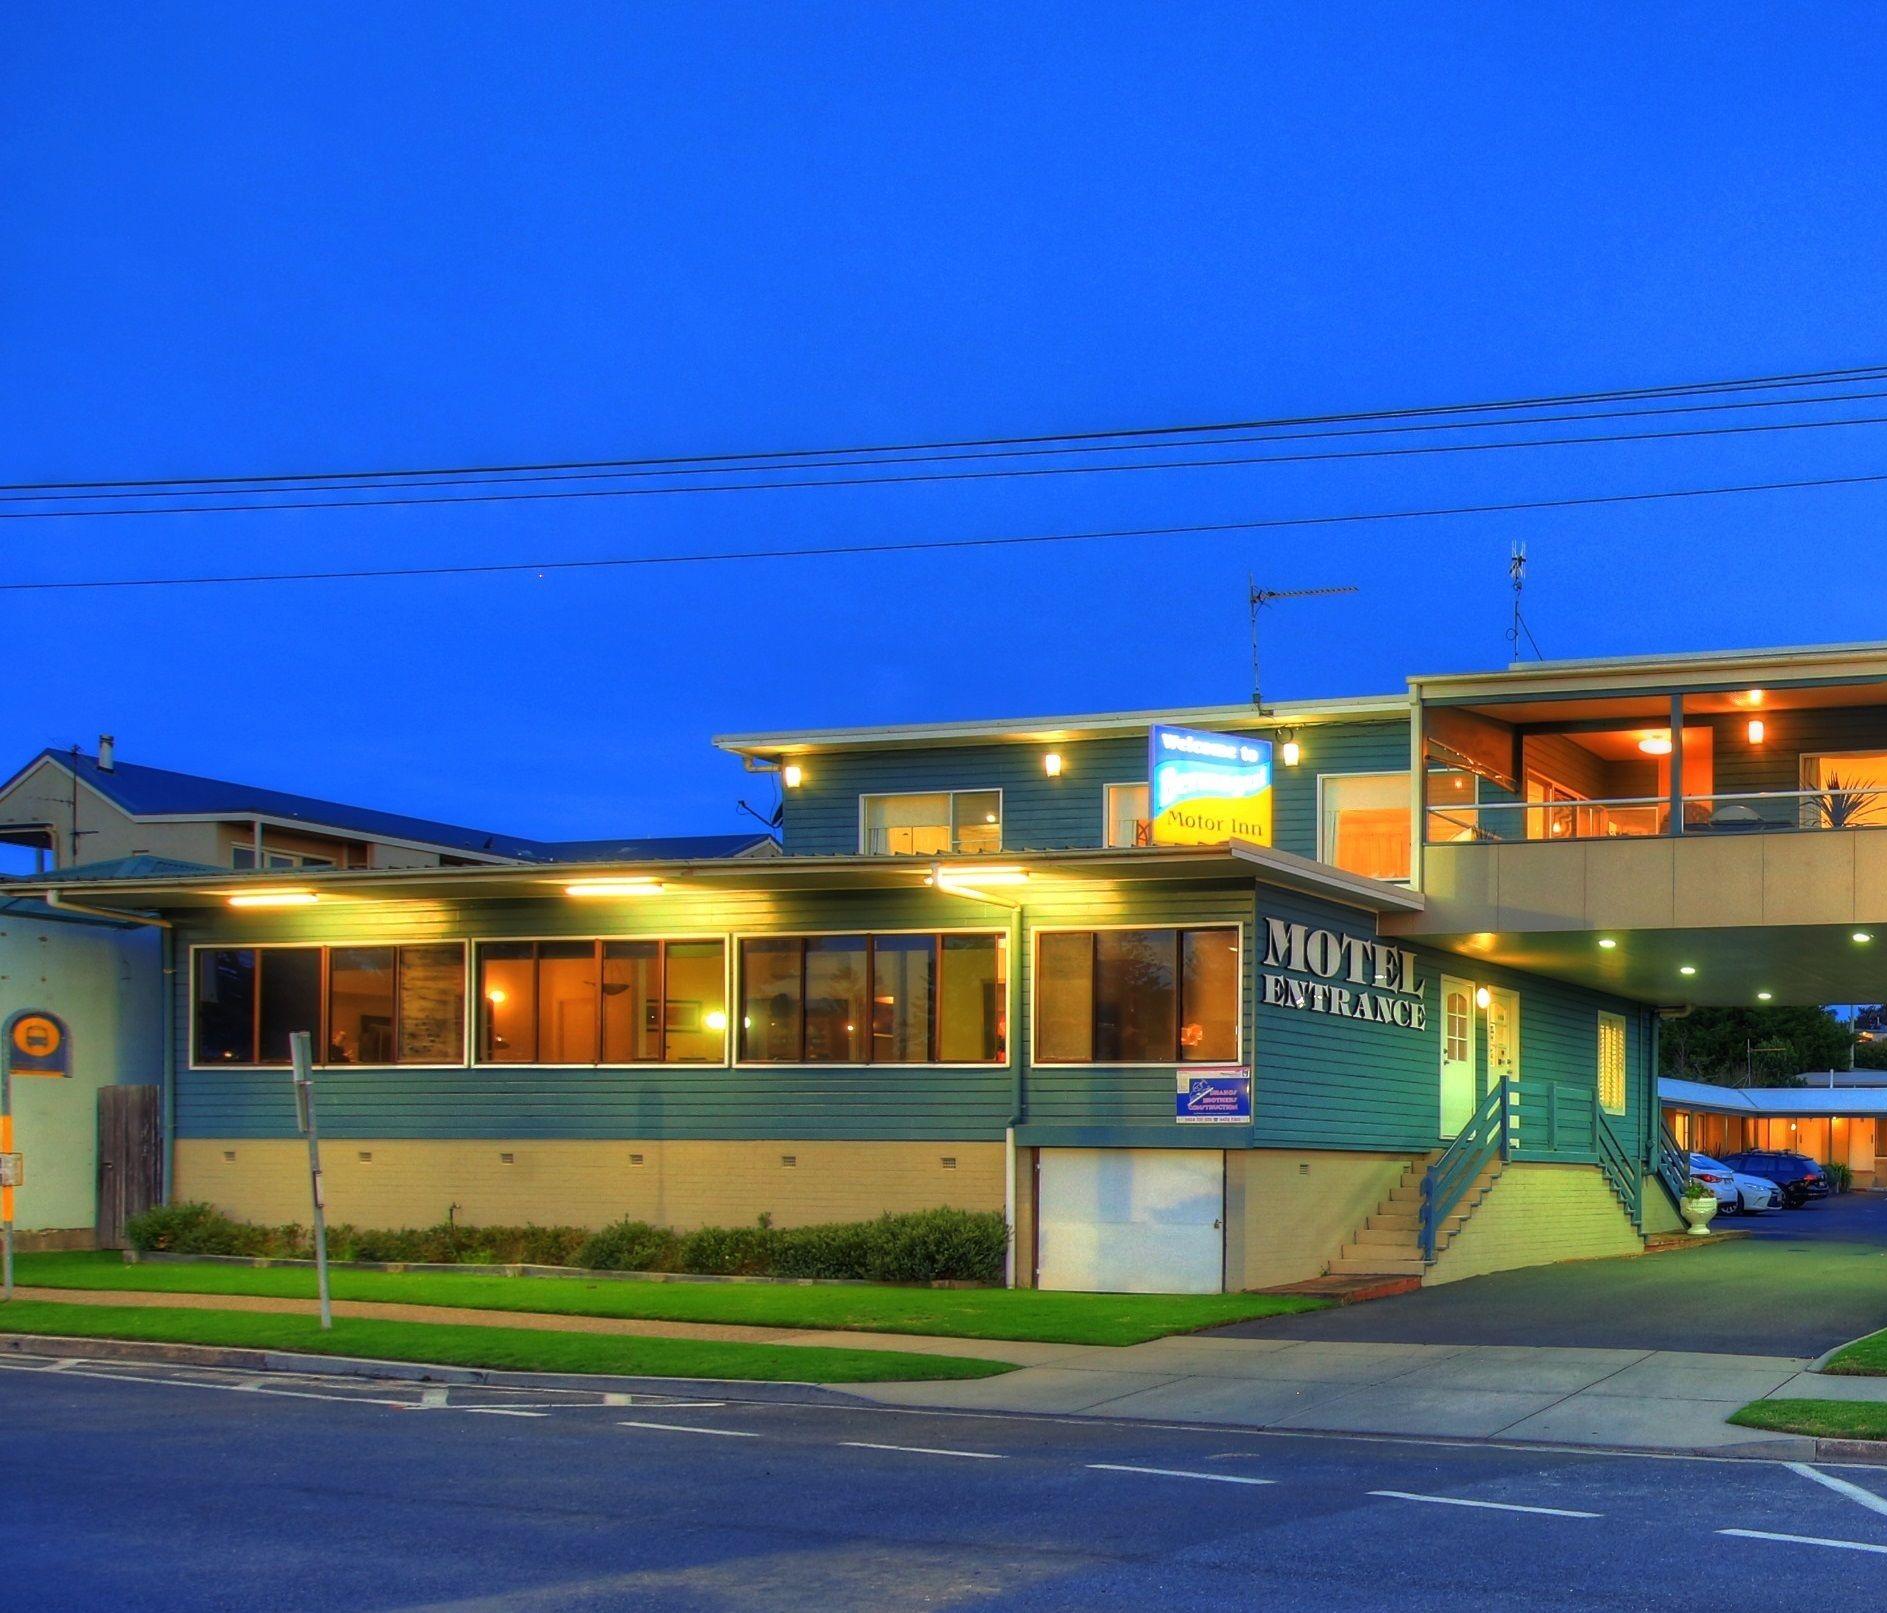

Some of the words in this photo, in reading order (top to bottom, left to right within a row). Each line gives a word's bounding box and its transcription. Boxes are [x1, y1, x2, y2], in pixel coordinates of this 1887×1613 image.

[1168, 810, 1224, 832] Motor
[1232, 819, 1262, 836] Inn
[1263, 917, 1426, 999] MOTEL
[1263, 973, 1426, 1031] ENTRANCE
